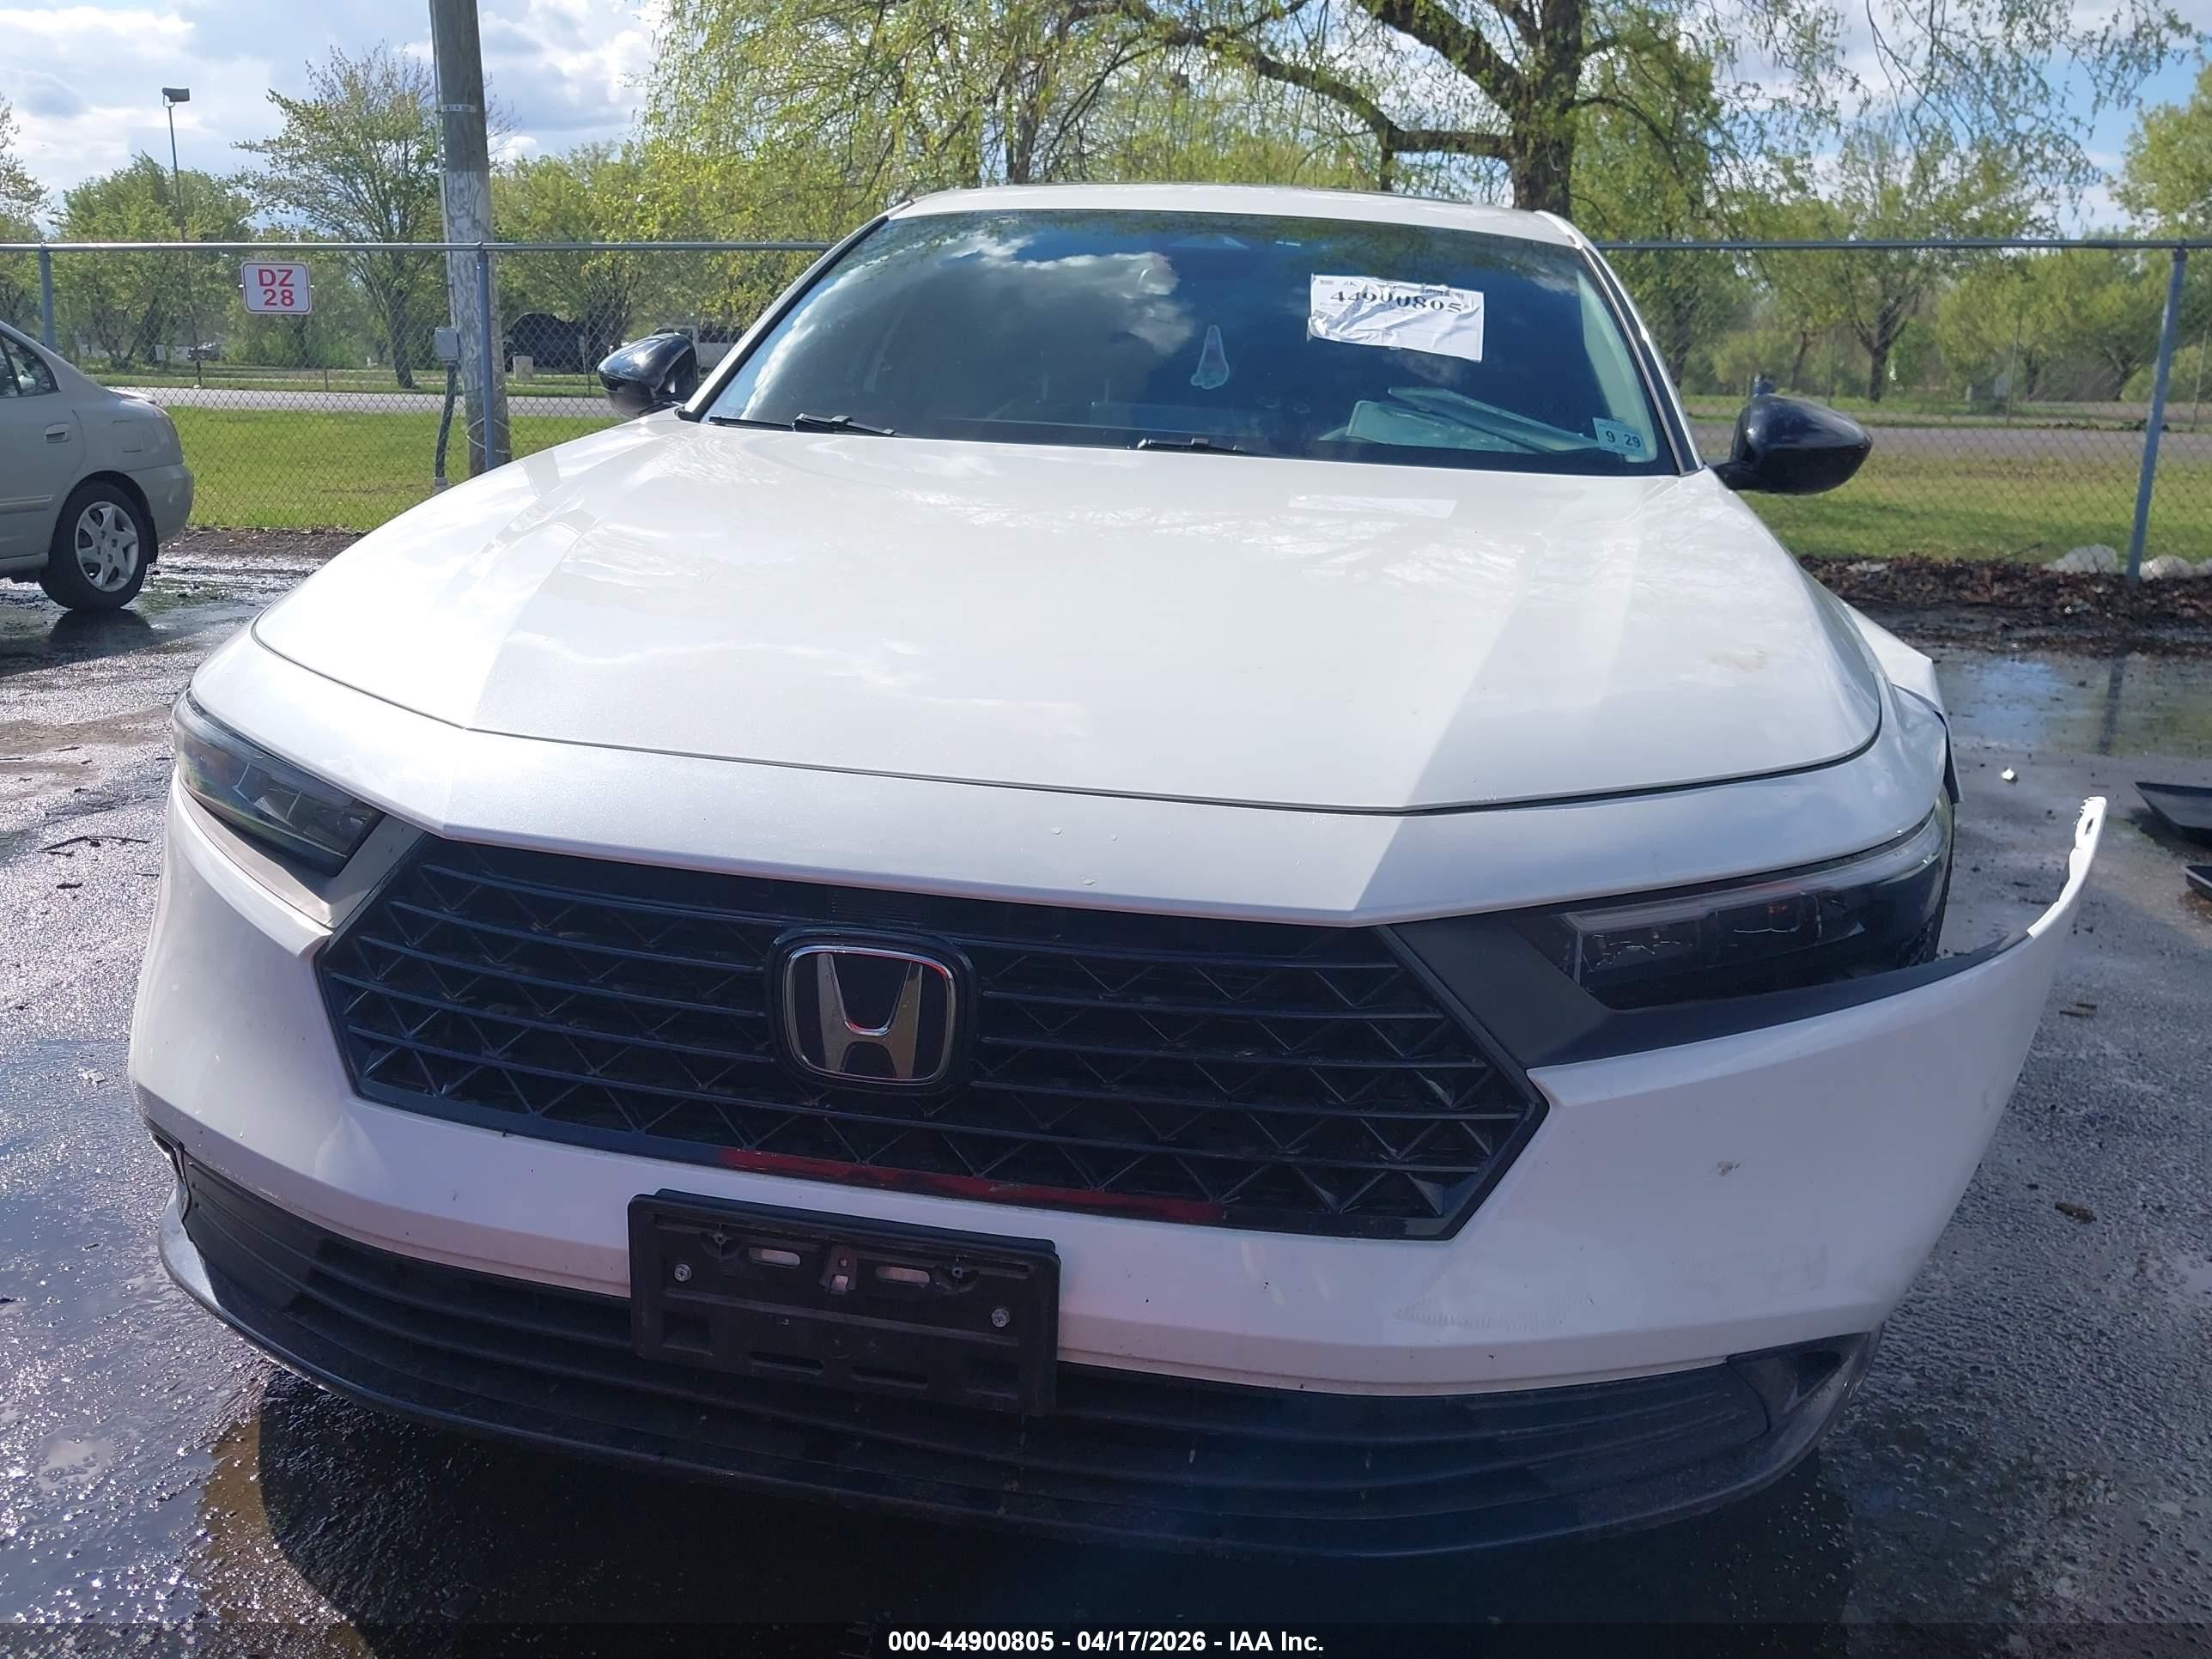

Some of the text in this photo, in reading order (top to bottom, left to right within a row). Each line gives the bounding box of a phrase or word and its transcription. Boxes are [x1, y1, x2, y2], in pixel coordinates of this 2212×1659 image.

[258, 268, 295, 287] DZ
[263, 289, 295, 307] 28
[1605, 429, 1641, 448] 9 29
